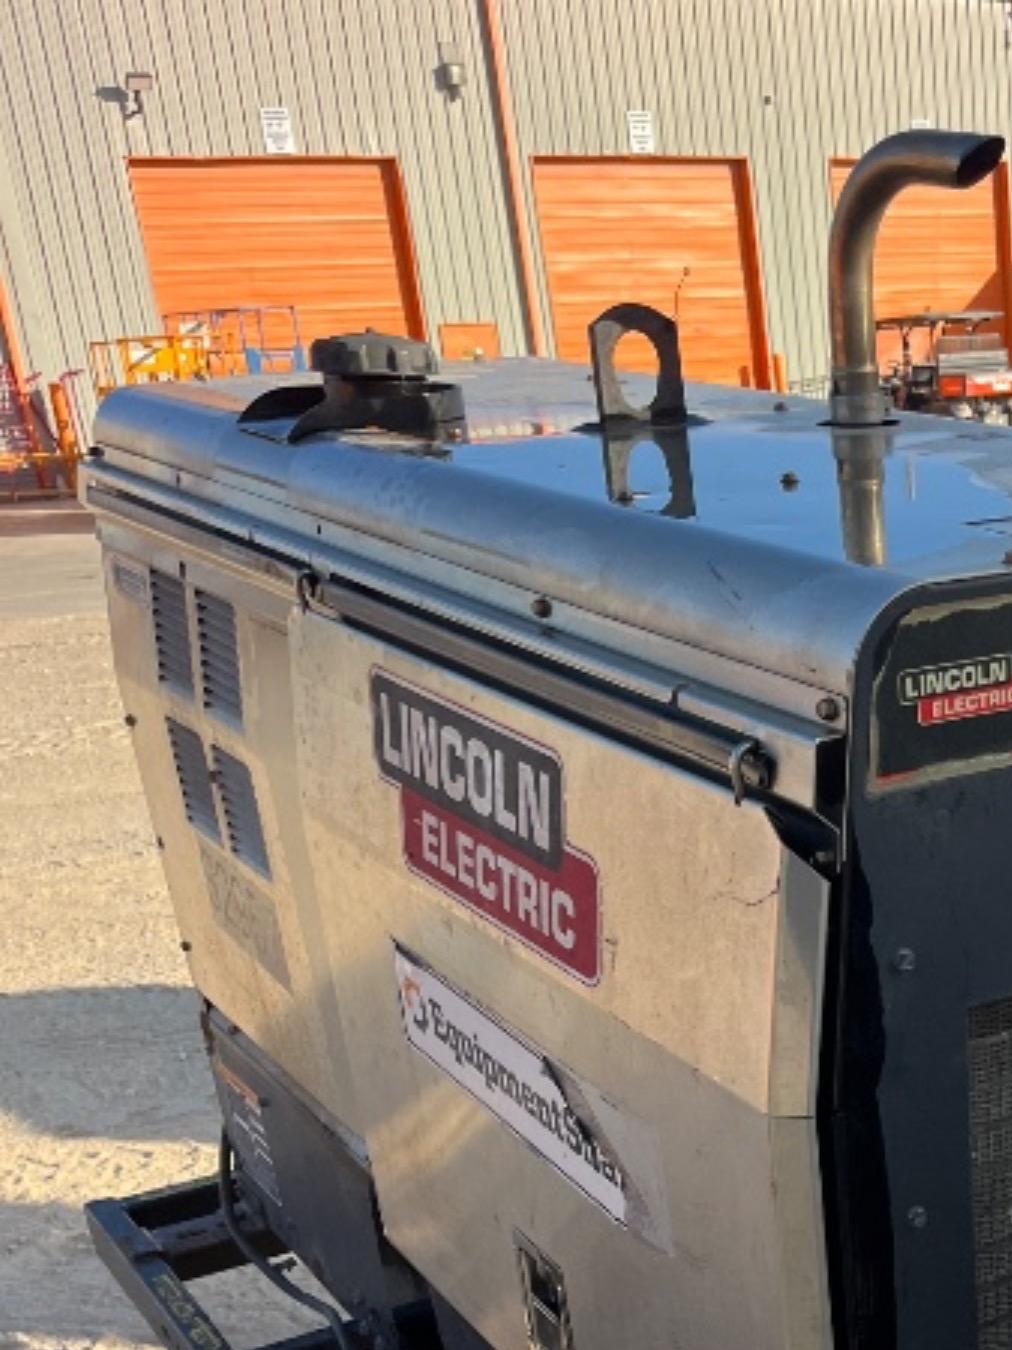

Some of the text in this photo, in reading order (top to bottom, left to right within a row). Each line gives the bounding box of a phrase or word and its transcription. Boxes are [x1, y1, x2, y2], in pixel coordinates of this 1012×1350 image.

[904, 659, 1007, 698] LINCOLN
[380, 692, 550, 852] LINCOLN
[421, 810, 577, 950] ELECTRIC
